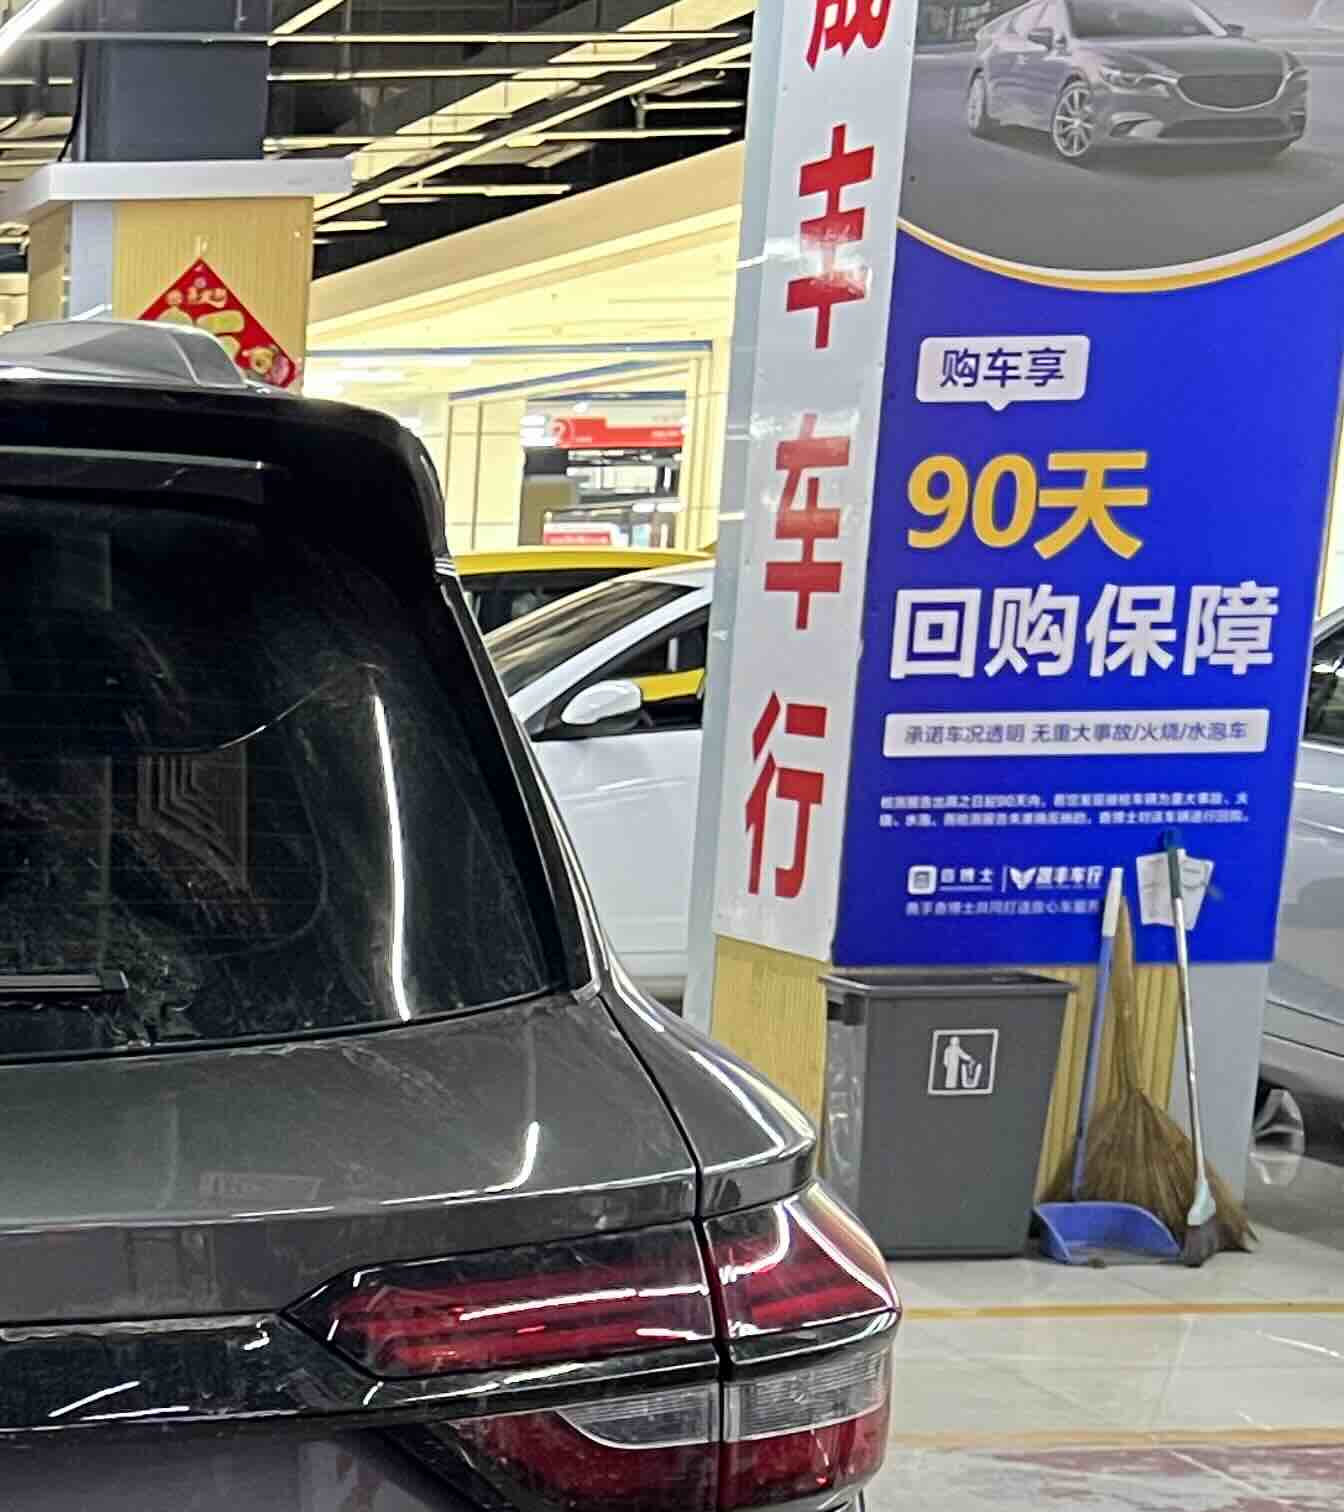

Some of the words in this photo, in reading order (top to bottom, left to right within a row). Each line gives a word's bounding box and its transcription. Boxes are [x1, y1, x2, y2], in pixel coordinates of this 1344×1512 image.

[940, 347, 1067, 389] 购车享
[907, 452, 1150, 560] 90天
[891, 582, 1279, 679] 回购保障
